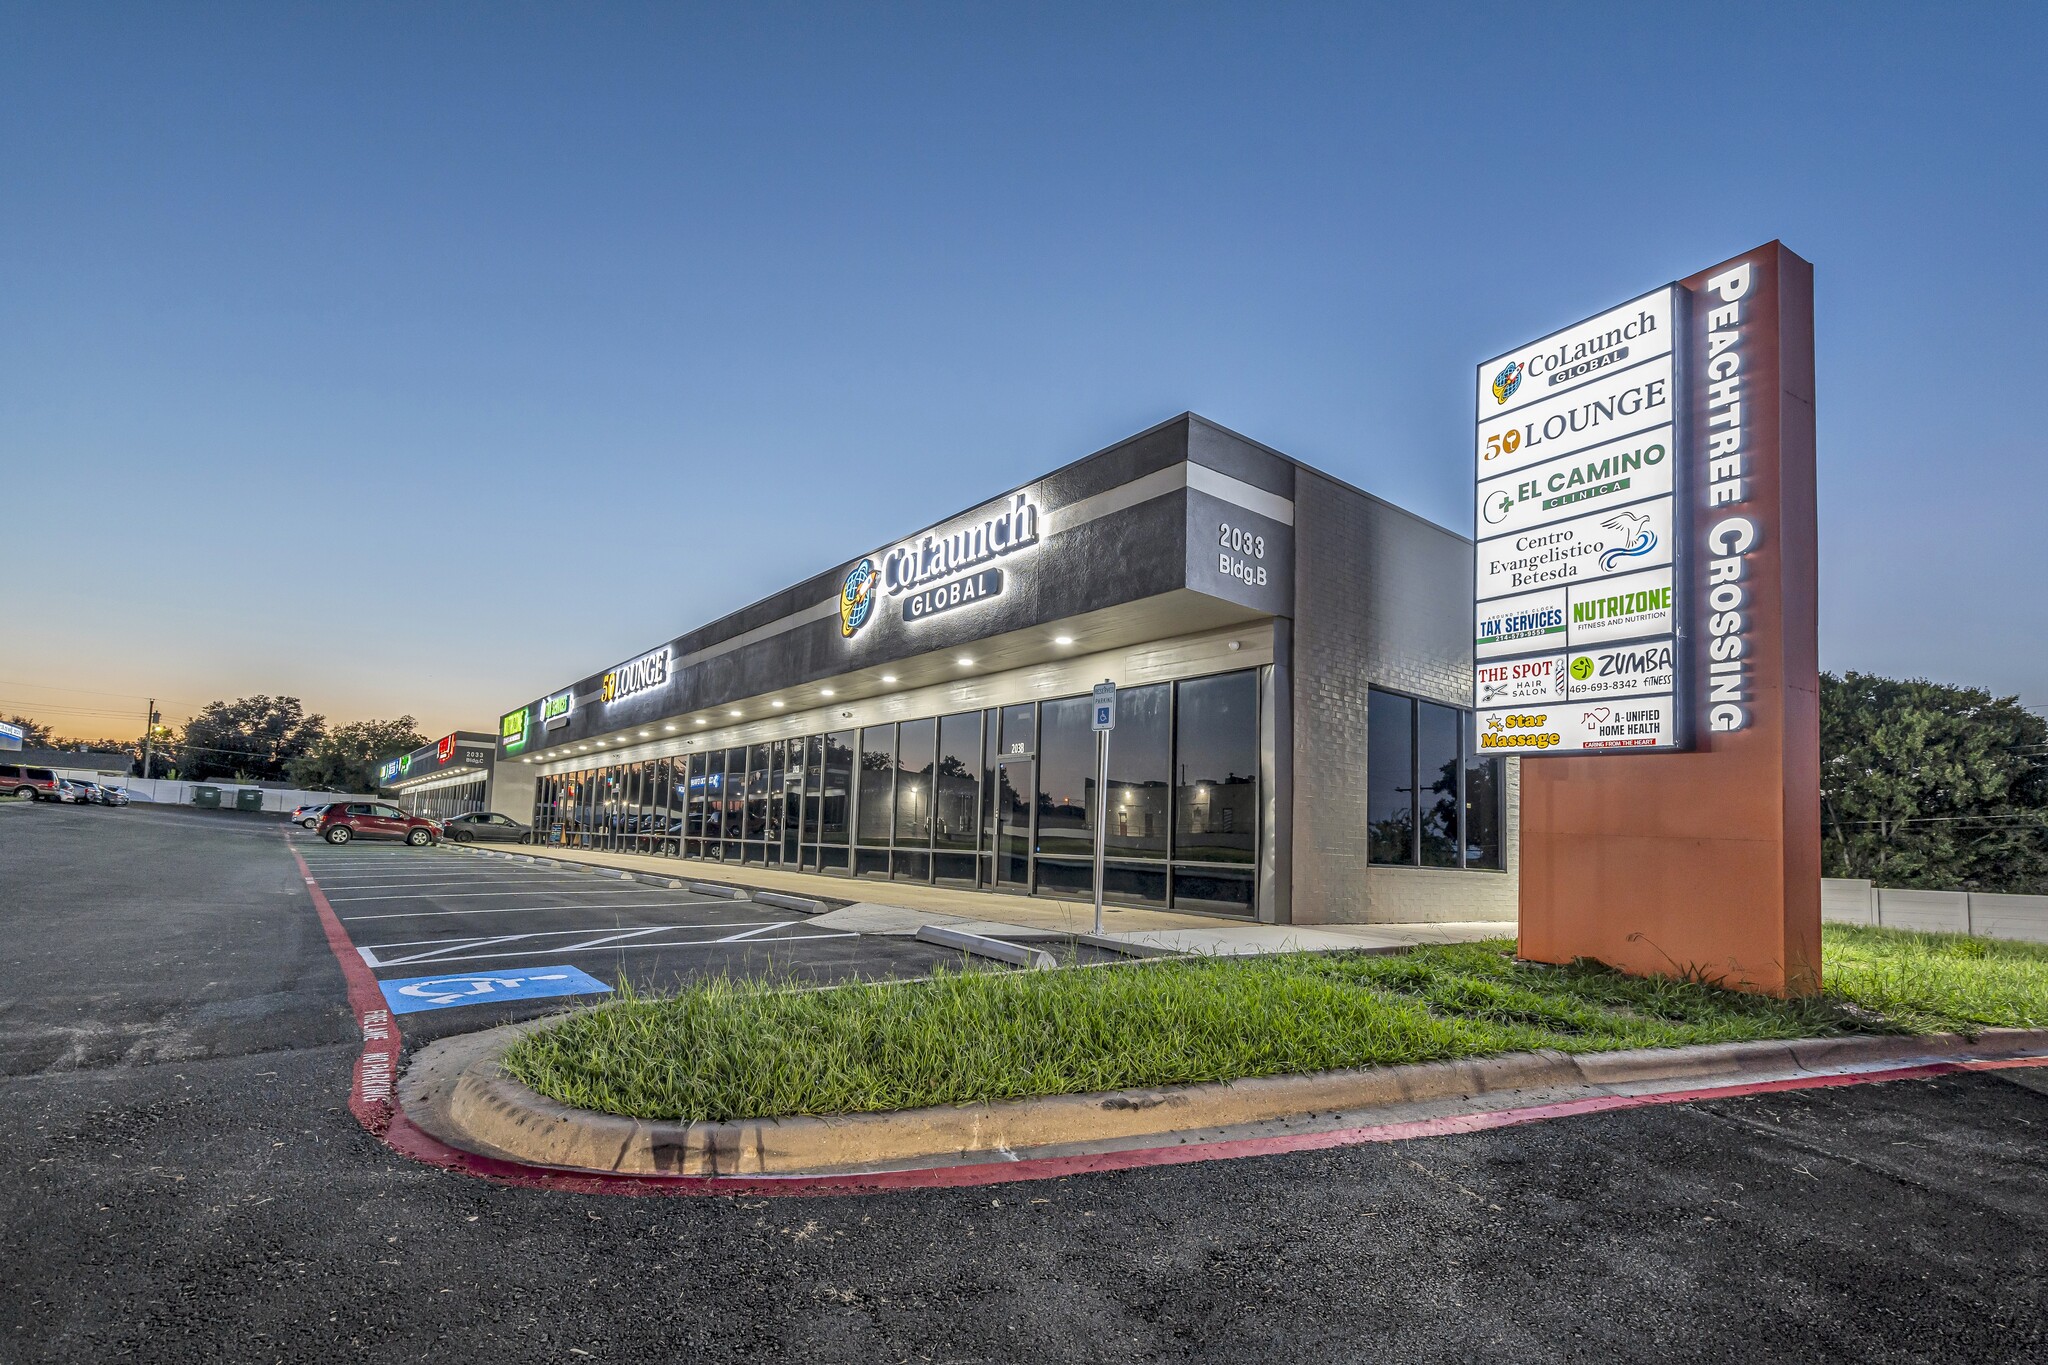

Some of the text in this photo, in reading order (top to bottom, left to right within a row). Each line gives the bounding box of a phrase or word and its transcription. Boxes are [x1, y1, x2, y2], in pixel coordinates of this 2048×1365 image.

[1528, 311, 1657, 377] CoLaunch
[1556, 351, 1621, 383] GLOBAL
[1708, 262, 1750, 507] PEACHTREE
[1525, 378, 1666, 448] LOUNGE
[1518, 444, 1665, 502] EL CAMINO
[1550, 484, 1622, 508] CLINICA
[881, 493, 1040, 593] CoLaunch
[1219, 523, 1265, 559] 2033
[1516, 530, 1573, 551] Centro
[1489, 541, 1604, 575] Evangelistico
[1511, 563, 1578, 587] Betesda
[911, 574, 987, 616] GLOBAL
[1573, 586, 1671, 624] NUTRIZONE
[1480, 608, 1562, 637] TAX SERVICES
[1577, 611, 1666, 631] FITNESS AND NUTRITION
[1709, 517, 1754, 731] CROSSING
[614, 651, 664, 697] LOUNGE
[1478, 661, 1553, 683] THE SPOT
[1598, 647, 1672, 677] ZUMBA
[1512, 687, 1547, 698] SALON
[1516, 681, 1542, 689] HAIR
[1569, 679, 1638, 694] 469-693-8342
[1480, 732, 1560, 749] Massage
[1599, 722, 1660, 737] HOME HEALTH
[361, 1063, 391, 1101] PARKING
